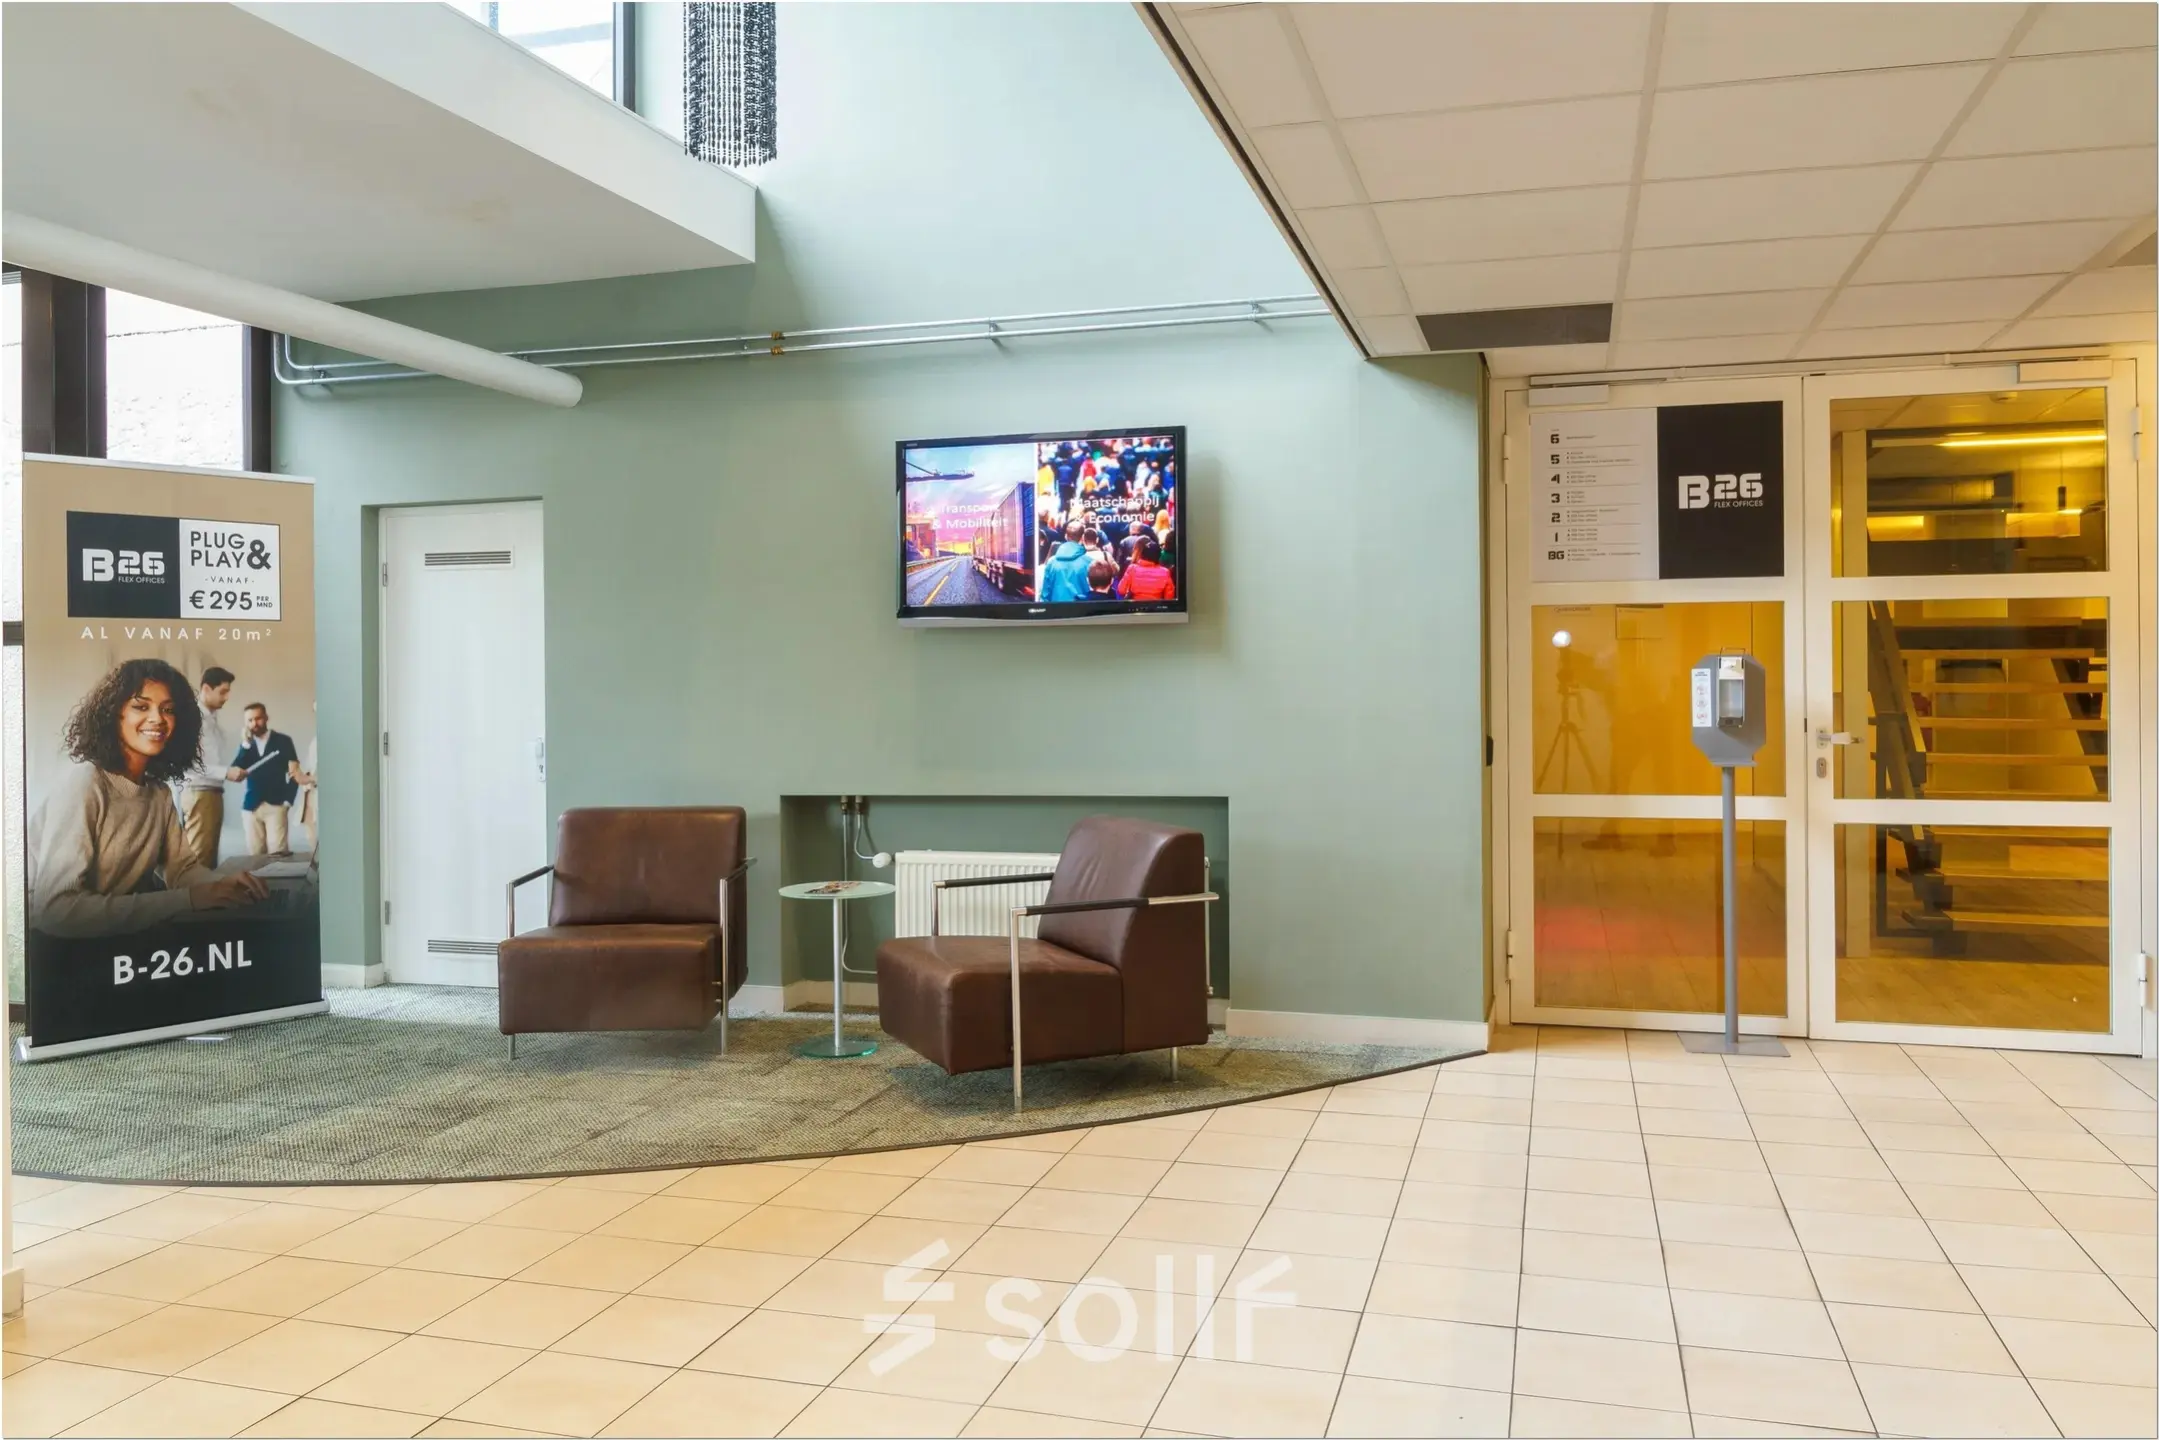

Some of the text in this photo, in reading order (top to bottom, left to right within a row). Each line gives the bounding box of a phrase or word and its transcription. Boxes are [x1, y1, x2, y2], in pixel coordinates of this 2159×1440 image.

[1550, 433, 1560, 444] 6
[1550, 454, 1560, 465] 5
[1550, 473, 1560, 484] 4
[1678, 472, 1764, 509] B26
[1551, 493, 1560, 503] 3
[1732, 499, 1763, 507] OFFICES
[946, 516, 1009, 529] Mobiliteit
[1089, 511, 1155, 524] Economie
[1551, 512, 1560, 523] 2
[190, 530, 245, 549] PLUG
[1554, 532, 1558, 542] 1
[190, 549, 245, 568] PLAY
[246, 538, 272, 571] &
[82, 548, 165, 582] B26
[81, 626, 108, 640] AL
[124, 627, 204, 640] VANAF
[113, 939, 252, 985] B-26.NL
